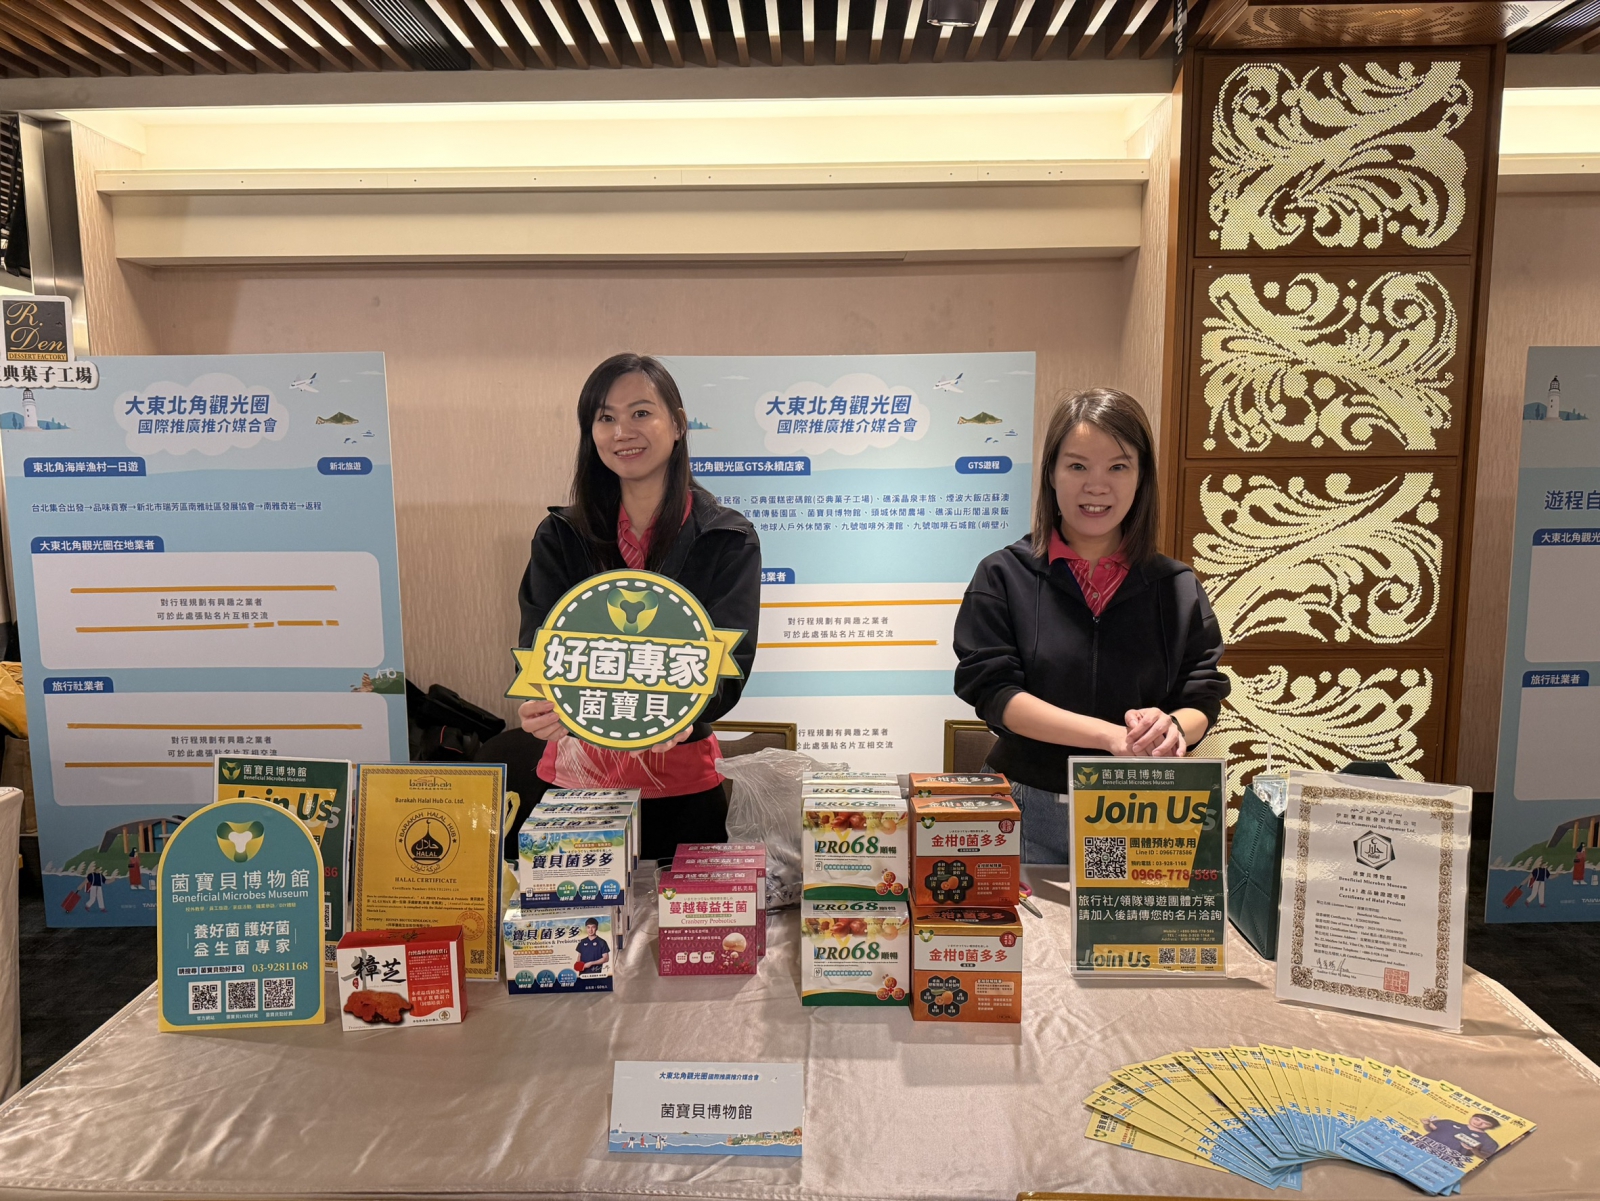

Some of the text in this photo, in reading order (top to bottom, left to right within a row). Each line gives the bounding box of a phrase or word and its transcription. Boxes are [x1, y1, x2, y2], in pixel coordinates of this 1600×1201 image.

[6, 301, 43, 326] R.
[10, 326, 65, 351] Den
[37, 353, 66, 361] FACTORY
[0, 364, 92, 384] 典菓子工場
[125, 394, 270, 416] 大東北角觀光圈
[765, 394, 912, 416] 大東北角觀光圈
[137, 418, 278, 434] 國際推廣推介媒合會
[777, 418, 917, 434] 國際推廣推介媒合會
[33, 461, 139, 473] 東北角海岸漁村一日遊
[330, 461, 362, 471] 新北旅遊
[968, 460, 1000, 470] GTS遊程
[32, 503, 85, 512] 台北集合出發
[305, 501, 322, 510] 返程
[1544, 489, 1600, 511] 遊程自
[1541, 532, 1600, 543] 大東北角觀光
[40, 540, 155, 551] 大東北角觀光圈在地業者
[156, 611, 268, 621] 可於此處張貼名片互相交流
[787, 617, 889, 626] 對行程規劃有興趣之業者
[783, 630, 893, 639] 可於此處張貼名片互相交流
[546, 636, 708, 687] 好菌專家
[52, 680, 105, 691] 旅行社業者
[1530, 674, 1580, 685] 旅行社業者
[579, 689, 670, 722] 菌寶貝
[243, 764, 308, 777] 菌寶貝博物館
[1102, 769, 1175, 779] 菌寶貝博物館
[1084, 793, 1208, 825] Join Us
[401, 811, 457, 838] BARAKAH HALAL HUB
[815, 835, 879, 854] PRO68
[1130, 838, 1196, 849] 團體預約專用
[532, 852, 614, 869] 寶貝菌多多
[171, 869, 310, 893] 菌寶貝博物館
[1131, 869, 1217, 881] 0966-778-586
[172, 889, 309, 903] Beneficial Microbes Museum
[1078, 895, 1215, 907] 旅行社/領隊導遊團體方案
[669, 900, 747, 914] 蔓越莓益生菌
[813, 901, 879, 910] PRO68
[1079, 909, 1222, 921] 請加入後請傳您的名片洽詢
[194, 920, 290, 939] 養好菌 護好菌
[513, 926, 580, 940] 寶貝菌多多
[194, 938, 290, 957] 益生菌專家
[814, 941, 880, 960] PRO68
[1078, 949, 1151, 968] Join Us
[252, 962, 308, 973] 03-9281168
[352, 954, 406, 983] 樟芝
[661, 1103, 753, 1120] 菌寶貝博物館
